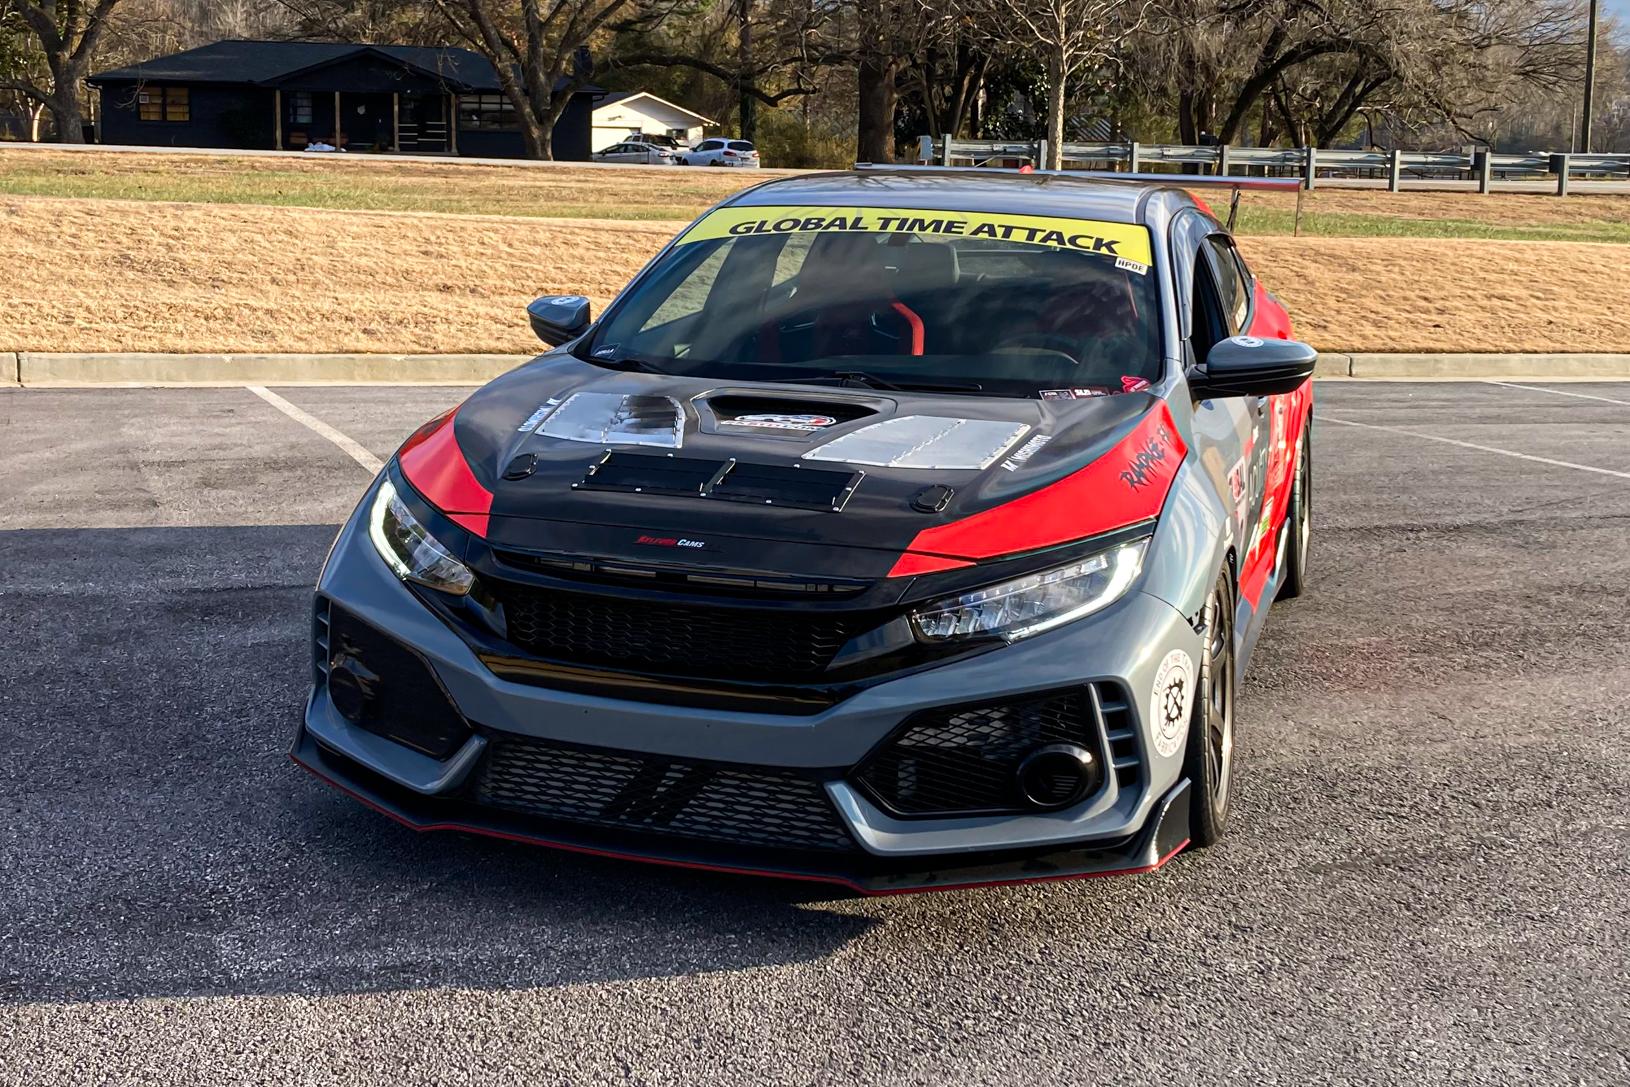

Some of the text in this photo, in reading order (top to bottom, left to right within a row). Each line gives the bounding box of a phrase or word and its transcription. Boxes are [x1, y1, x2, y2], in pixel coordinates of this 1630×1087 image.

[728, 216, 1121, 255] GLOBAL TIME ATTACK
[1117, 258, 1145, 272] HPDE
[677, 538, 705, 548] CAMS
